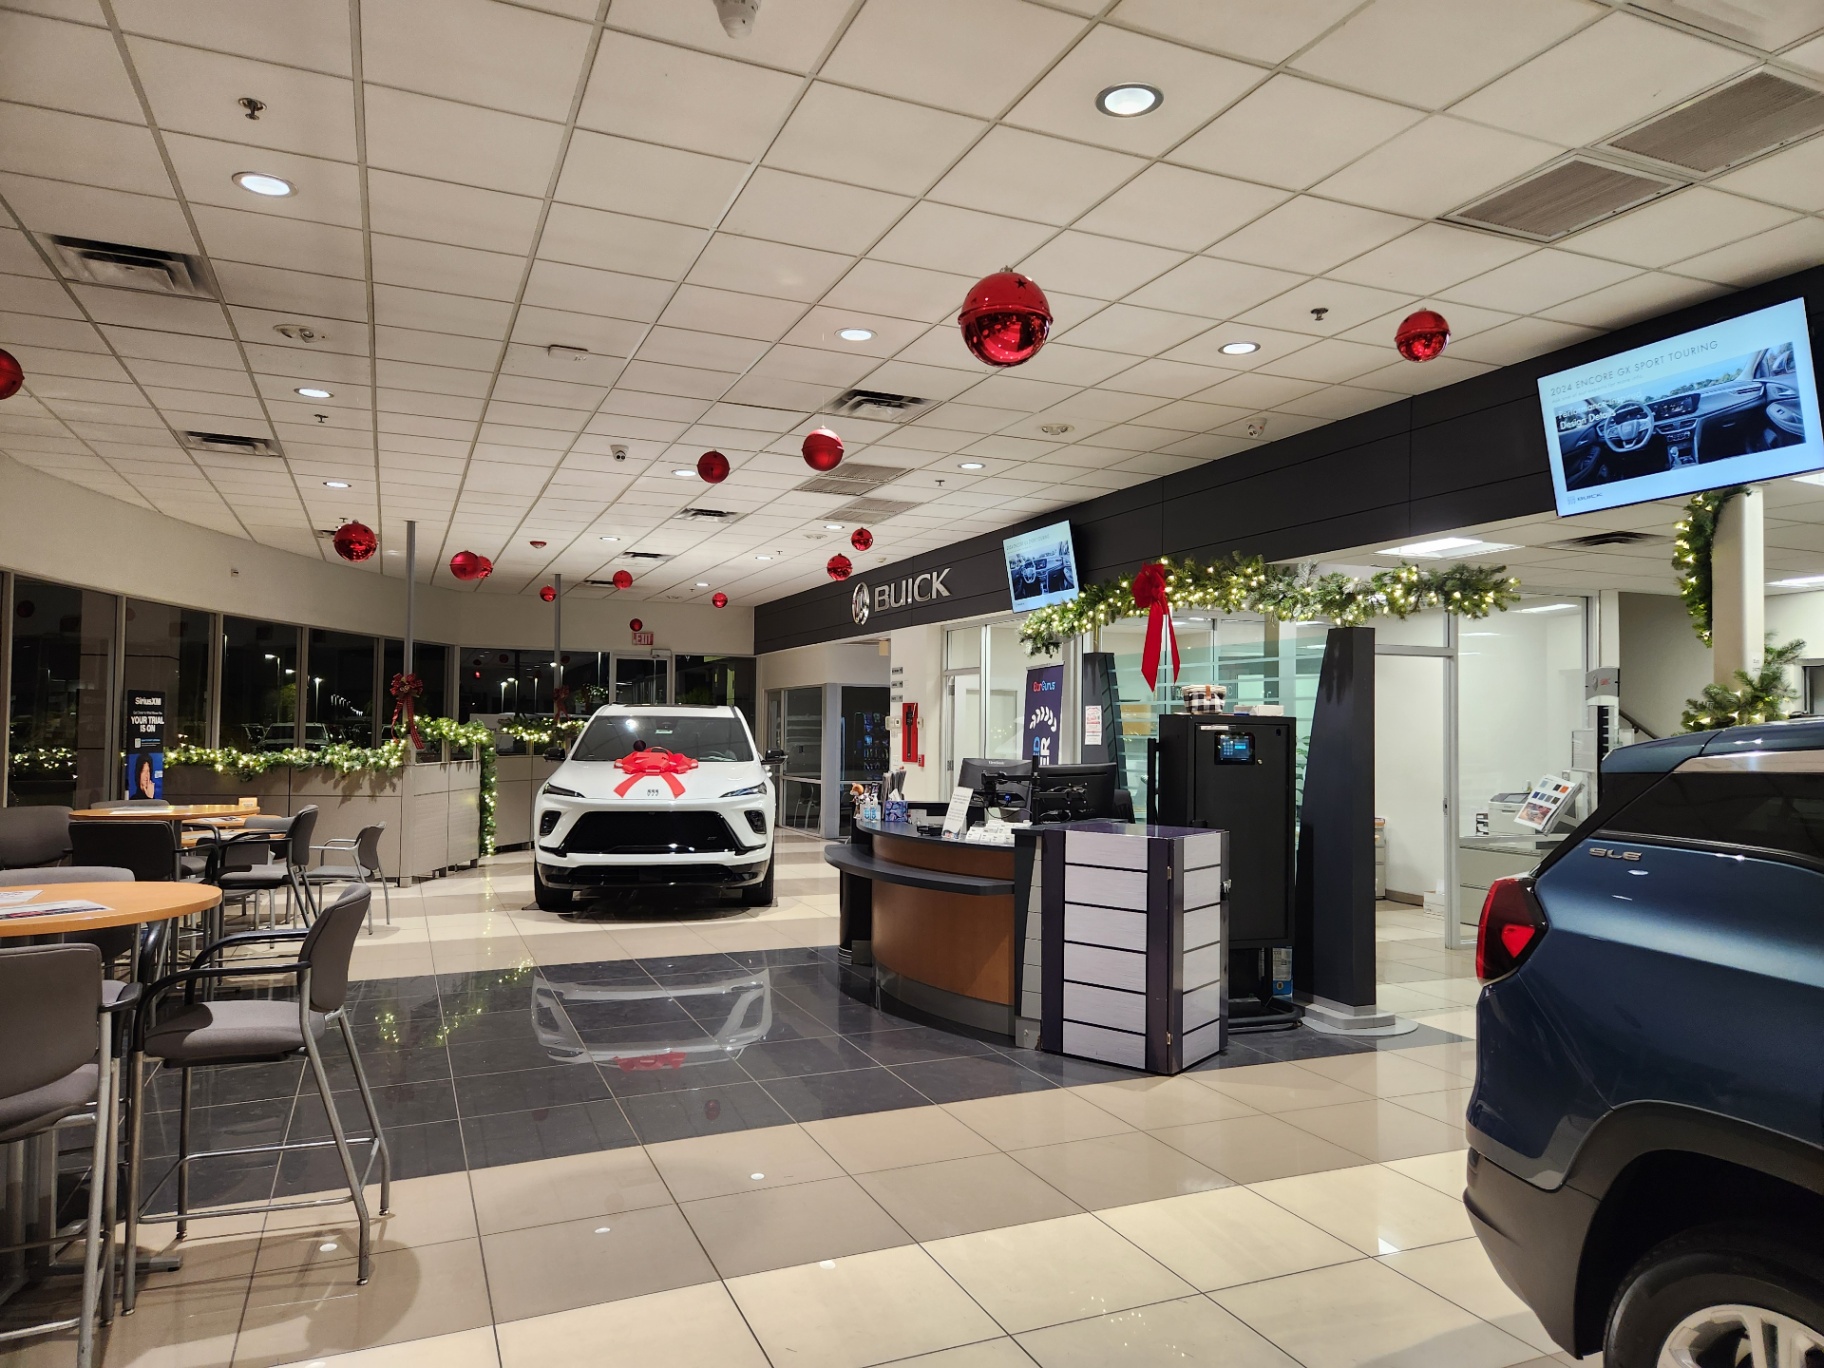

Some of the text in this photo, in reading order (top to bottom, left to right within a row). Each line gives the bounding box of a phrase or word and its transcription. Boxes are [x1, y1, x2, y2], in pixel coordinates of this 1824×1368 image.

[1550, 340, 1718, 397] 2024 ENCORE GX SPORT TOURING
[1560, 411, 1616, 430] Design Details
[874, 567, 952, 612] BUICK
[636, 634, 651, 644] EXIT
[131, 716, 164, 724] YOUR TRIAL
